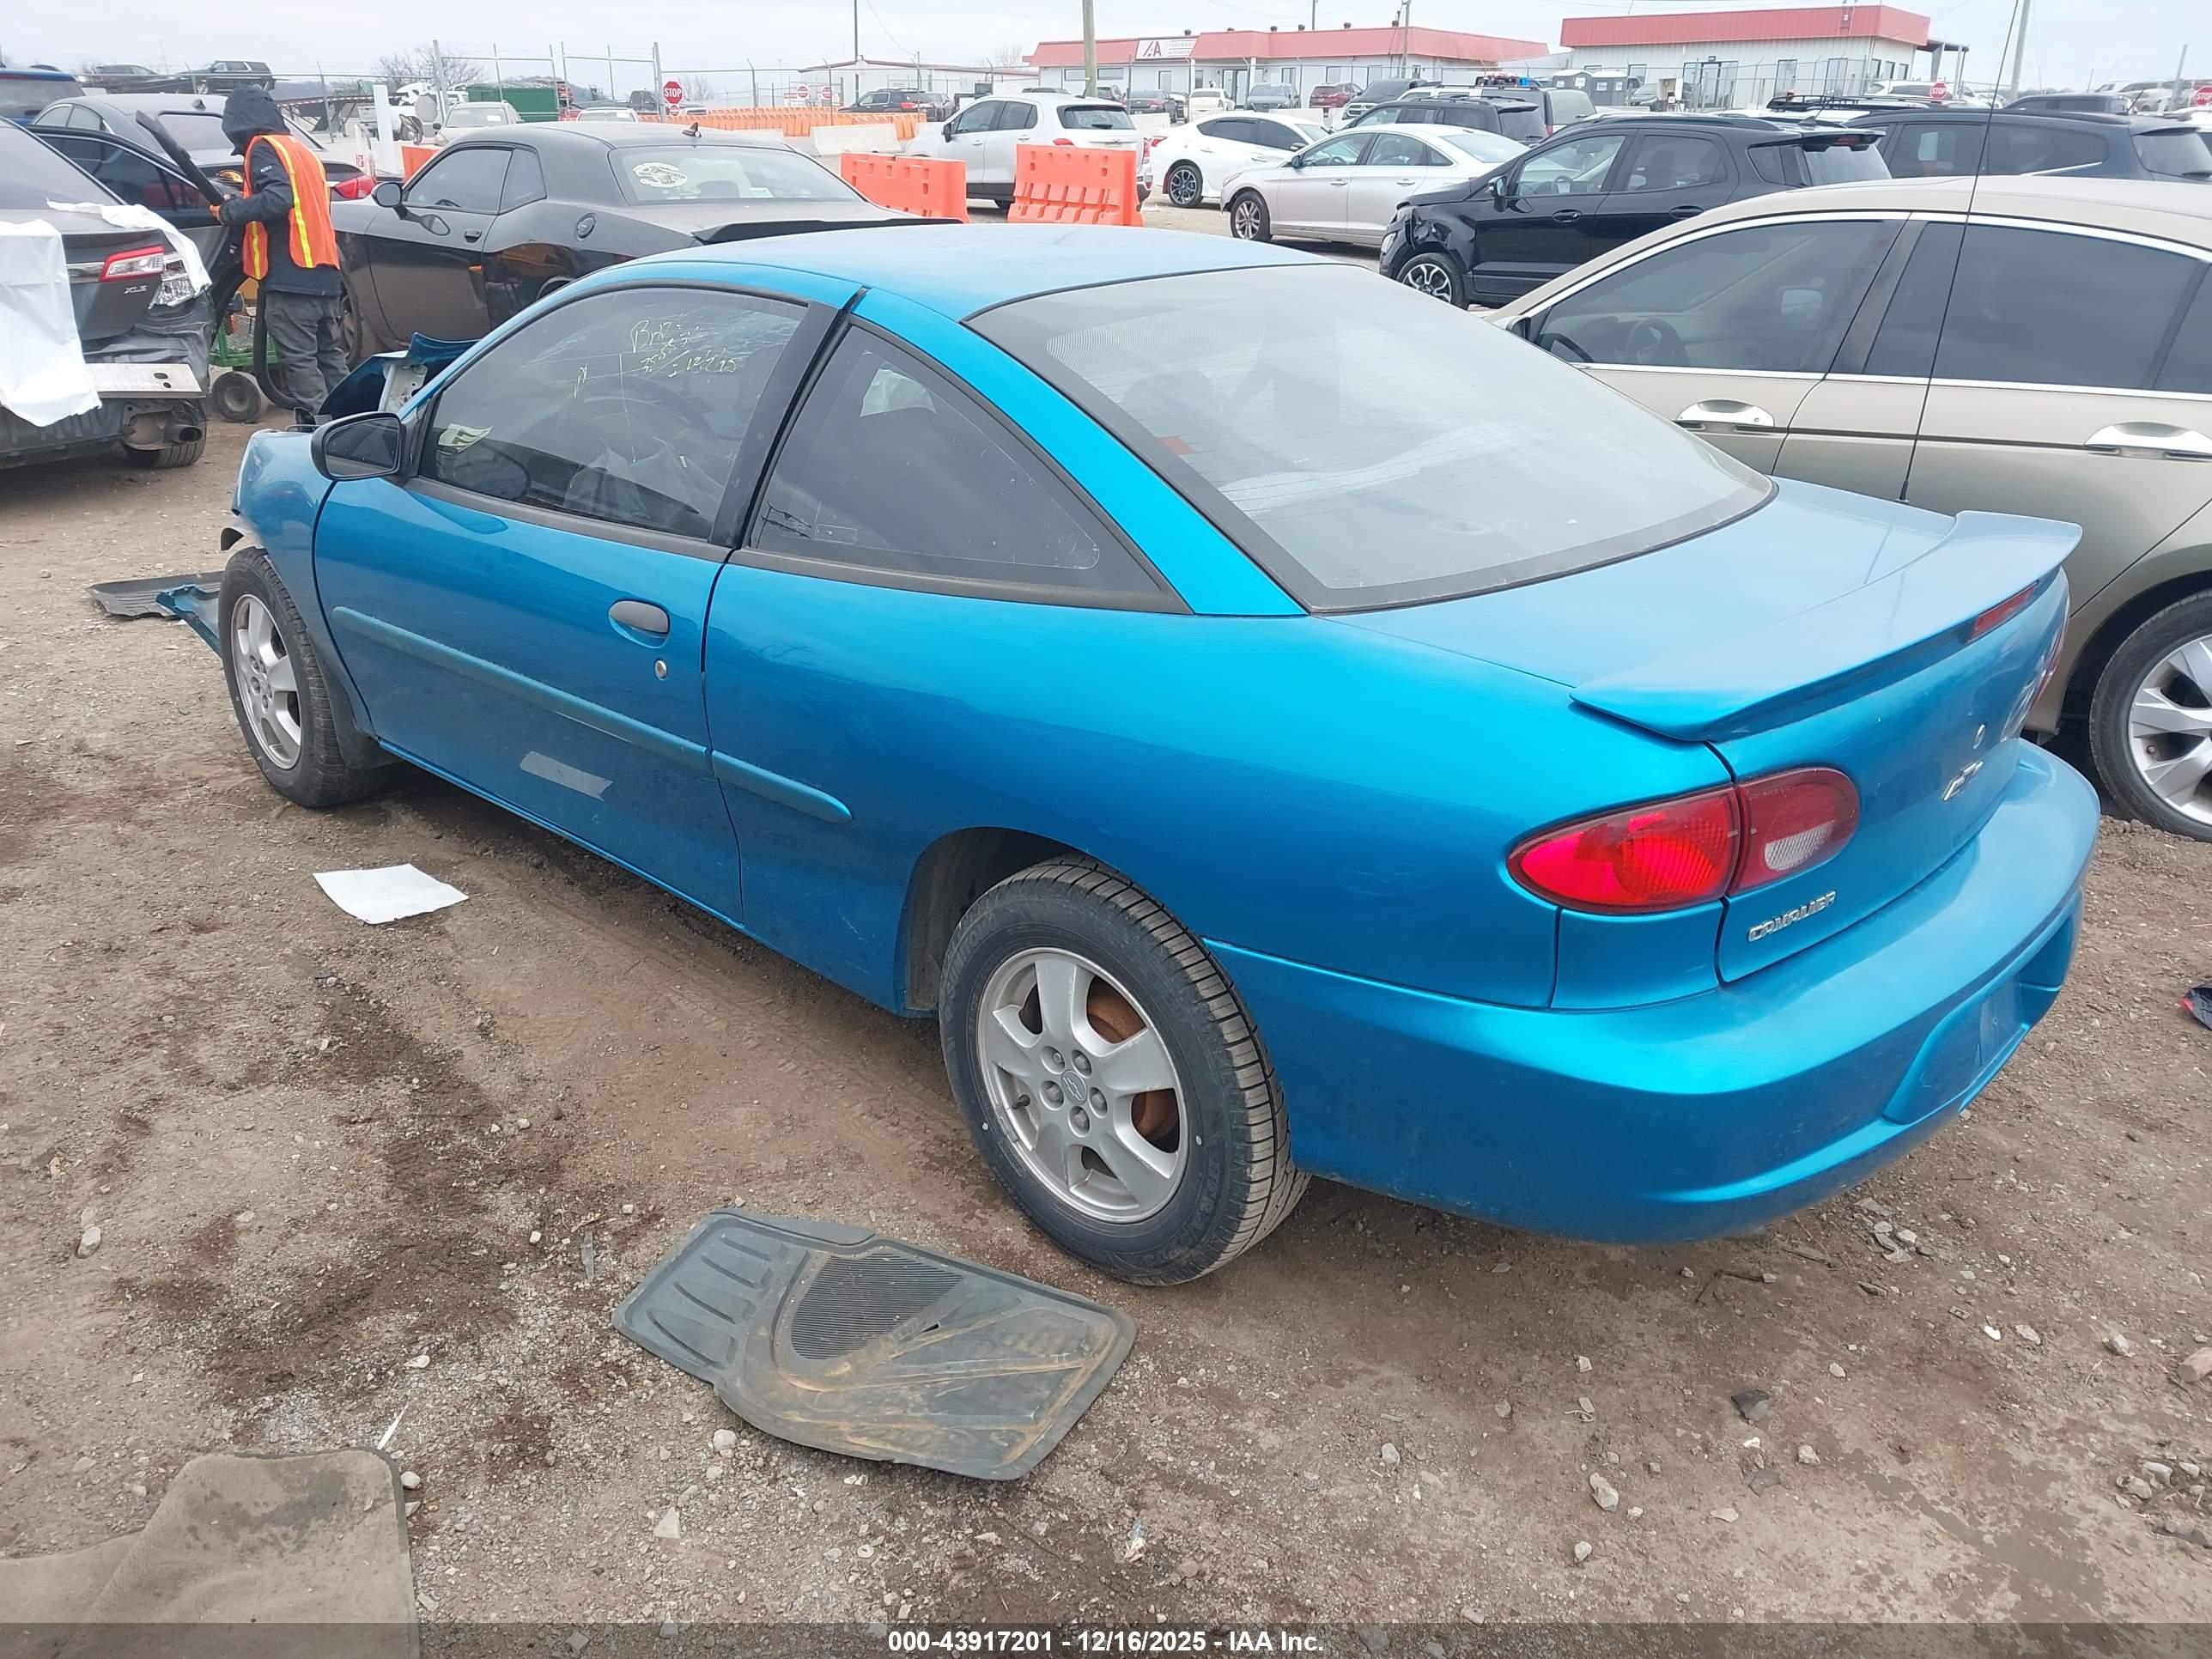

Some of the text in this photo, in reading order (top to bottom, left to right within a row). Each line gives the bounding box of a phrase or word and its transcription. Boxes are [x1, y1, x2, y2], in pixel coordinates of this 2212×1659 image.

[664, 88, 682, 98] STOP
[1932, 87, 1947, 95] STOP
[1748, 890, 1837, 943] CAVALIER
